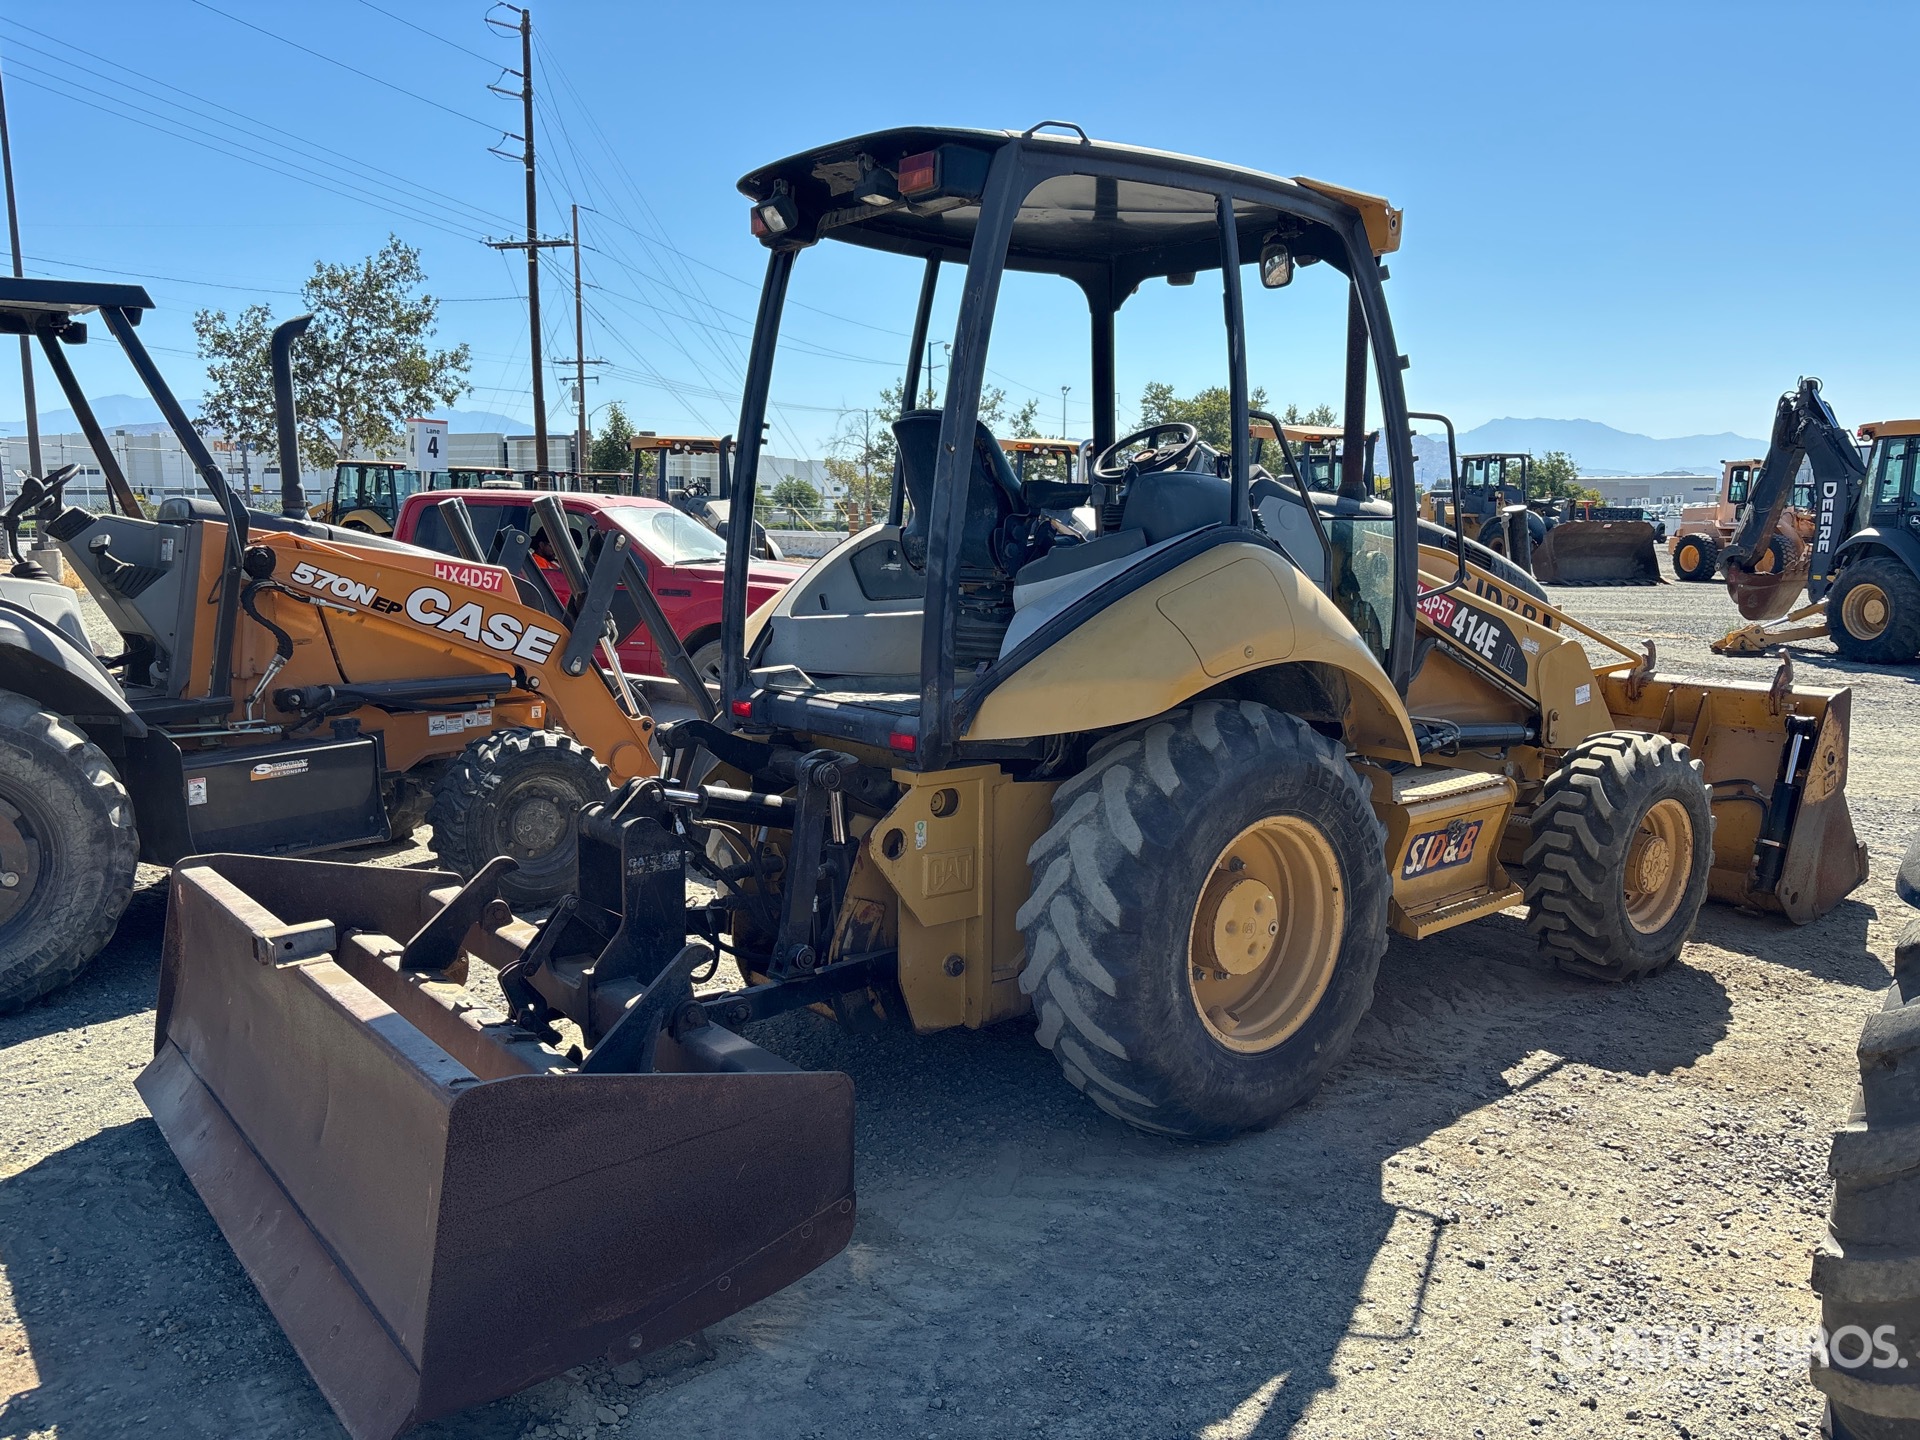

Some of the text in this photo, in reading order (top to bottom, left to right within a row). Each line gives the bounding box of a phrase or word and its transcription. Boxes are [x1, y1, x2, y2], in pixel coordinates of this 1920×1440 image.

[427, 436, 439, 458] 4
[1816, 481, 1838, 553] DEERE
[290, 561, 403, 615] 570N EP
[434, 563, 503, 590] HX4D57
[404, 586, 561, 665] CASE
[1451, 606, 1501, 660] 414E
[930, 854, 972, 891] CAT
